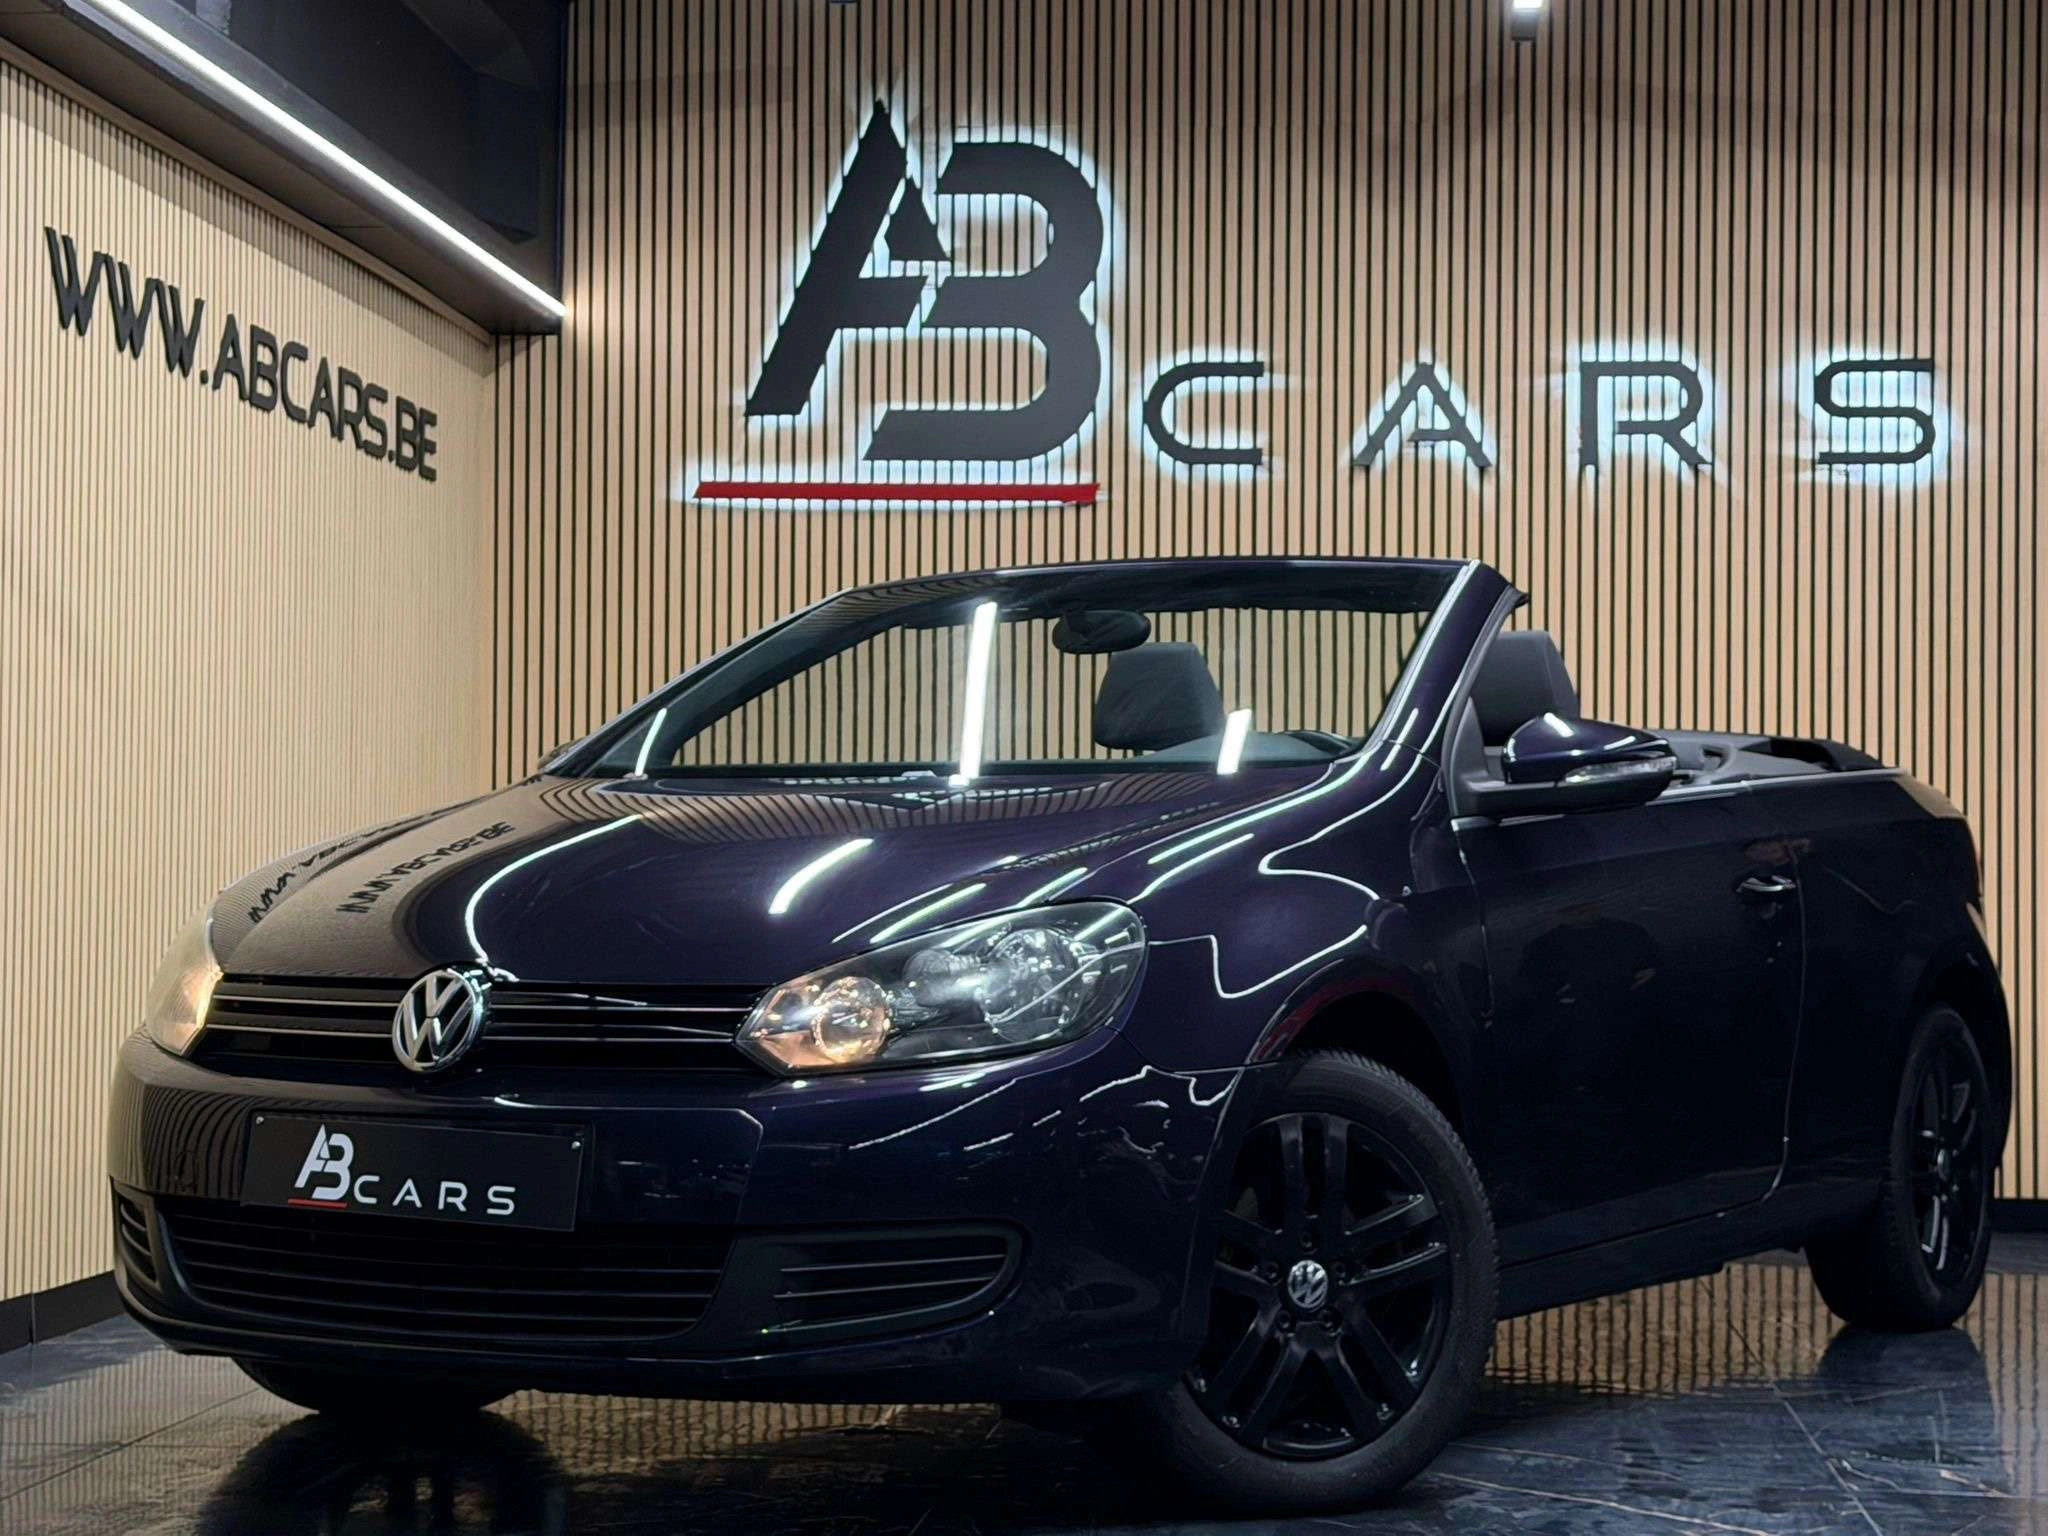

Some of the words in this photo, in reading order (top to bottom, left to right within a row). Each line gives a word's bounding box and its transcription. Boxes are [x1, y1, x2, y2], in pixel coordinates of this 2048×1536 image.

[44, 226, 437, 482] WWW.ABCARS.BE
[744, 98, 1104, 461] AB
[1141, 357, 1937, 473] CARS
[294, 1123, 354, 1201] AB
[353, 1174, 516, 1216] CARS
